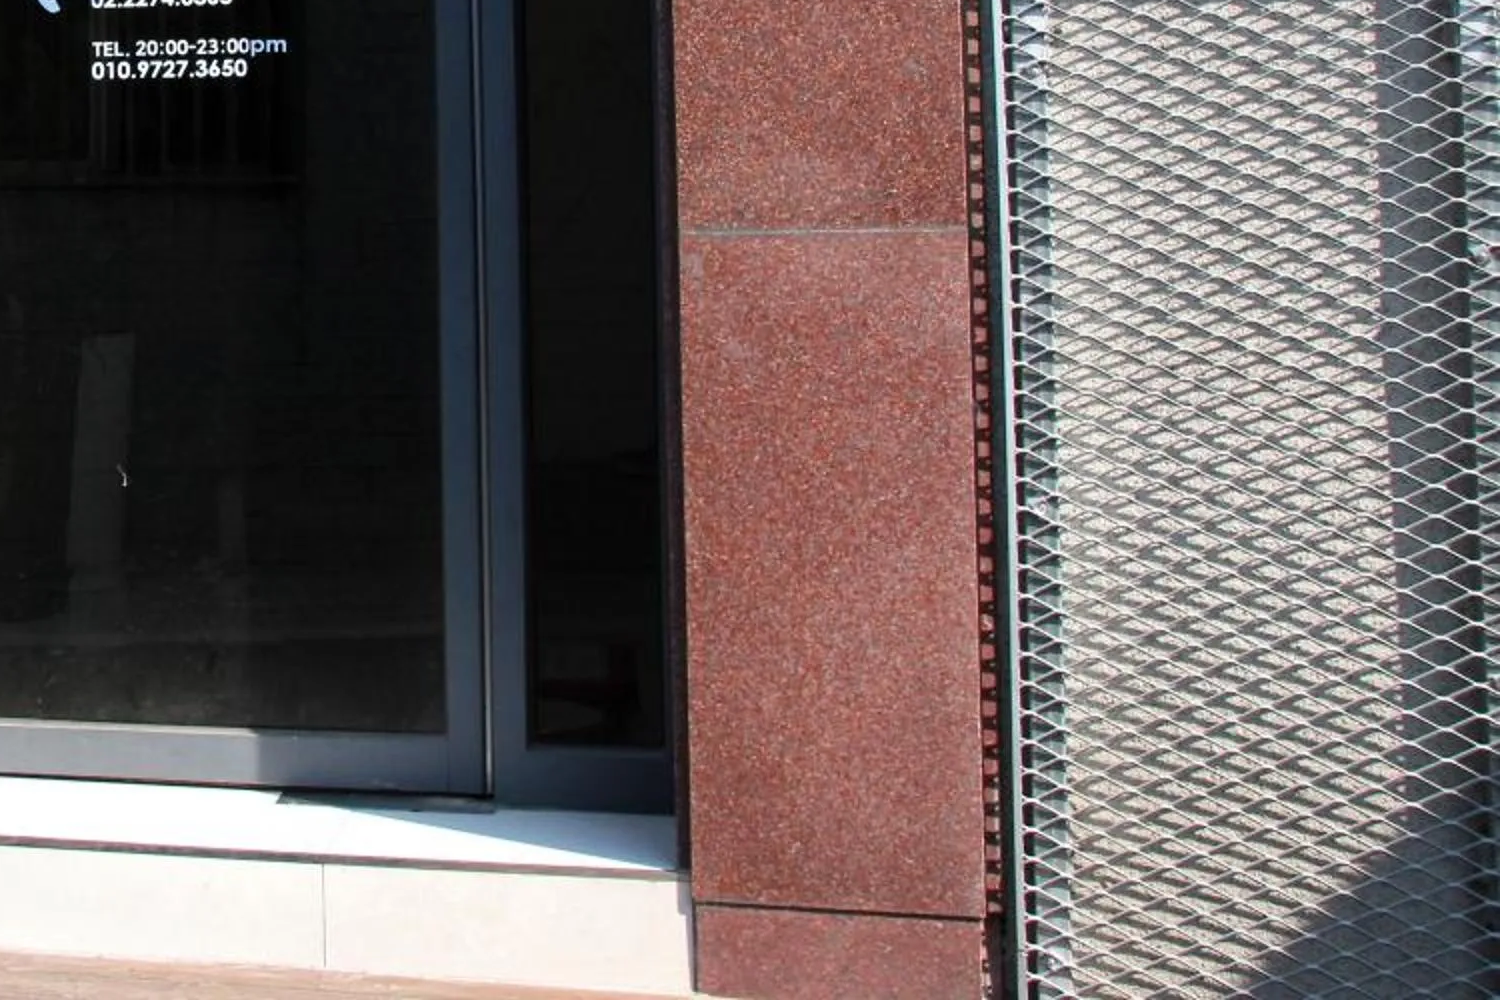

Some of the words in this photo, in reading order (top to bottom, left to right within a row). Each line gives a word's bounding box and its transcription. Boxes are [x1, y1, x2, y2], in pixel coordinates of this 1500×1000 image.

[91, 41, 130, 57] TEL.
[135, 37, 287, 58] 20:00-23:00pm
[91, 58, 248, 80] 010.9727.3650
